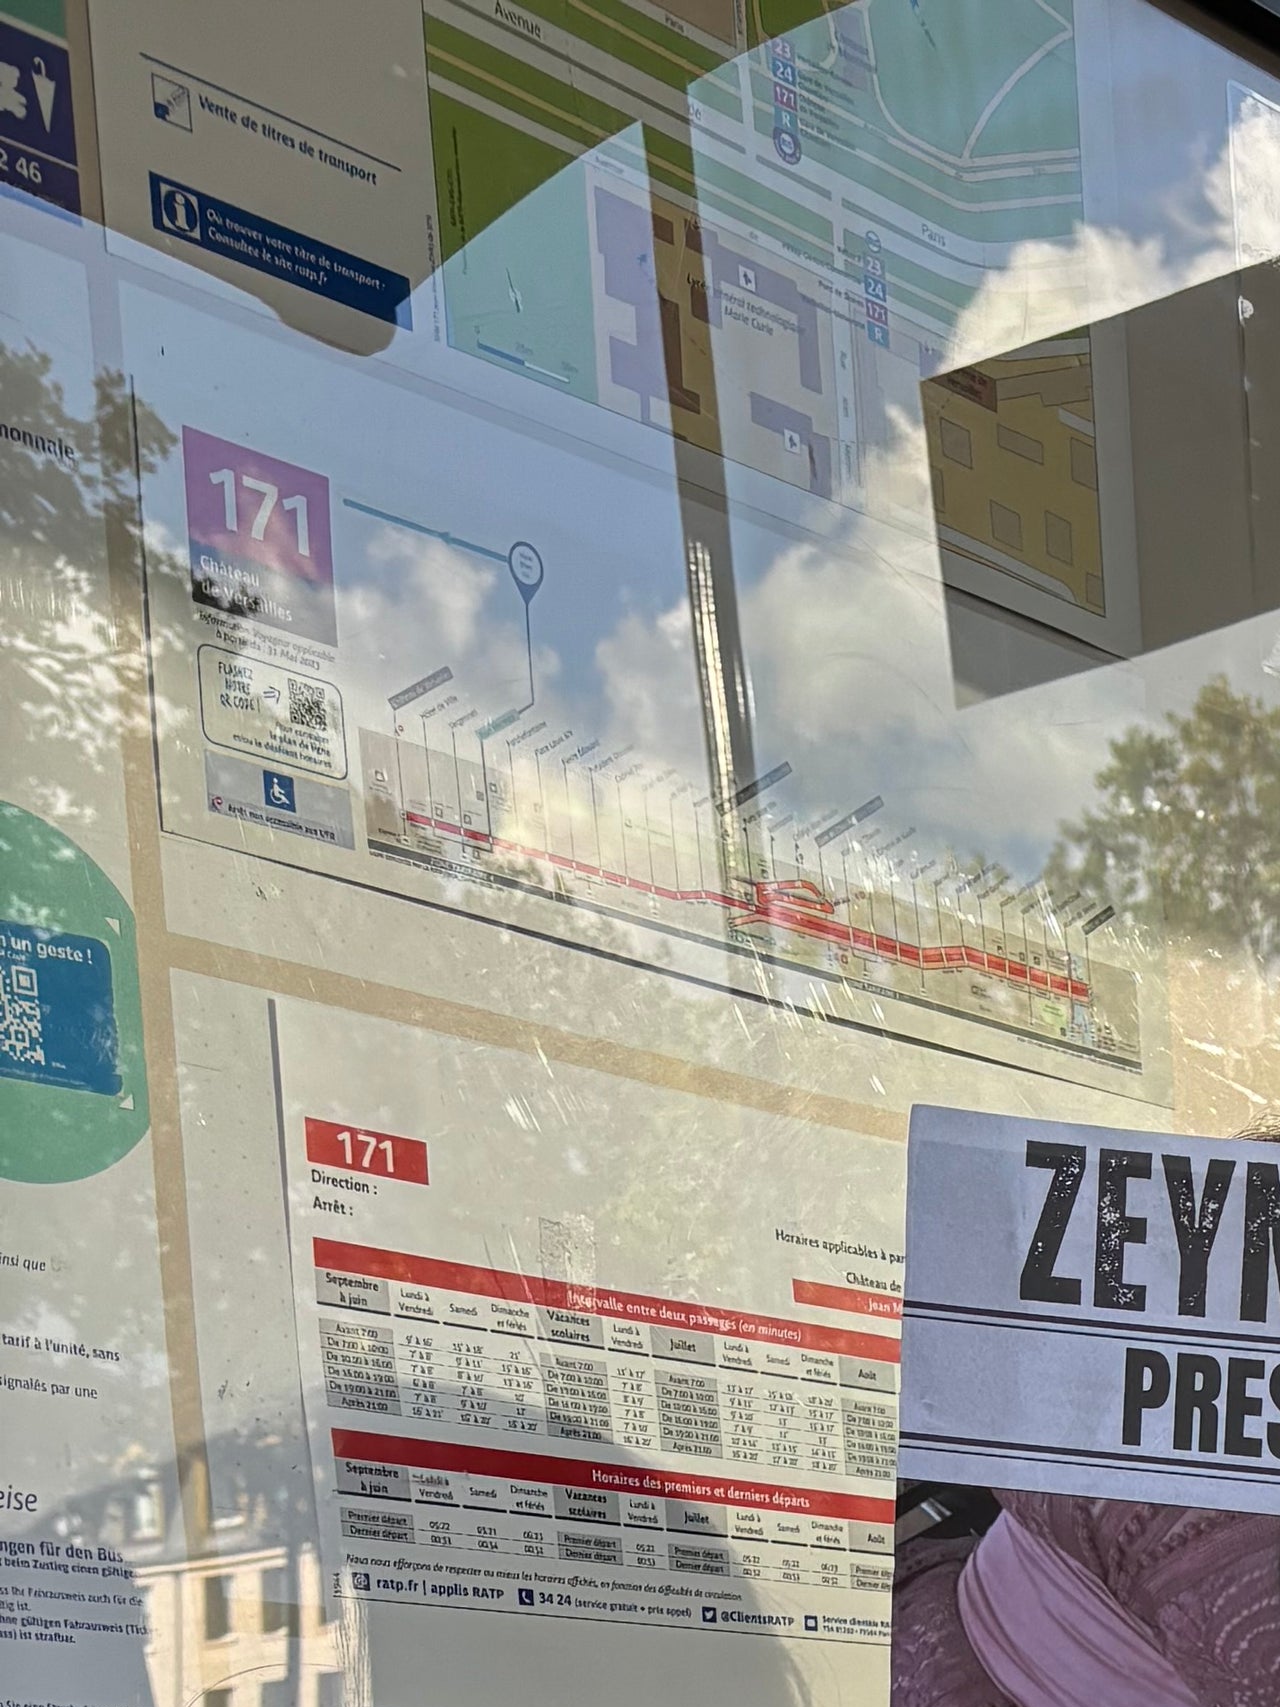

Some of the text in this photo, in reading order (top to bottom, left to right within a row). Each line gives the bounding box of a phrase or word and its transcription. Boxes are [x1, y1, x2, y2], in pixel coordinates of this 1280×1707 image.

[776, 62, 792, 83] 24
[775, 85, 795, 107] 171
[199, 94, 377, 185] Vente de titres de transport
[16, 157, 42, 183] 46
[921, 222, 946, 248] Paris
[319, 257, 330, 270] de
[865, 256, 882, 274] 23
[867, 278, 884, 298] 24
[867, 302, 886, 322] 171
[209, 467, 310, 557] 171
[200, 555, 259, 587] Château
[202, 579, 293, 622] de Versailles
[11, 936, 31, 952] un
[37, 943, 83, 962] geste
[337, 1130, 394, 1173] 171
[311, 1169, 369, 1194] Direction
[775, 1228, 886, 1260] Horaires applicables à
[23, 1258, 46, 1272] que
[326, 1272, 379, 1292] Septembre
[846, 1272, 902, 1293] Château de
[349, 1293, 367, 1307] juin
[546, 1310, 590, 1328] Vacances
[567, 1290, 801, 1342] Intervalle entre deux passages (en minutes)
[550, 1327, 590, 1343] scolaires
[2, 1333, 31, 1348] tarif
[34, 1337, 42, 1350] à
[93, 1348, 120, 1362] sans
[51, 1382, 98, 1399] par une
[345, 1461, 400, 1479] Septembre
[592, 1469, 810, 1509] Horaires des premiers et derniers départs
[40, 1541, 124, 1564] für den Bus
[376, 1577, 504, 1600] ratp.fr applis RATP
[538, 1591, 572, 1607] 34 24
[720, 1610, 795, 1627] @ClientsRATP
